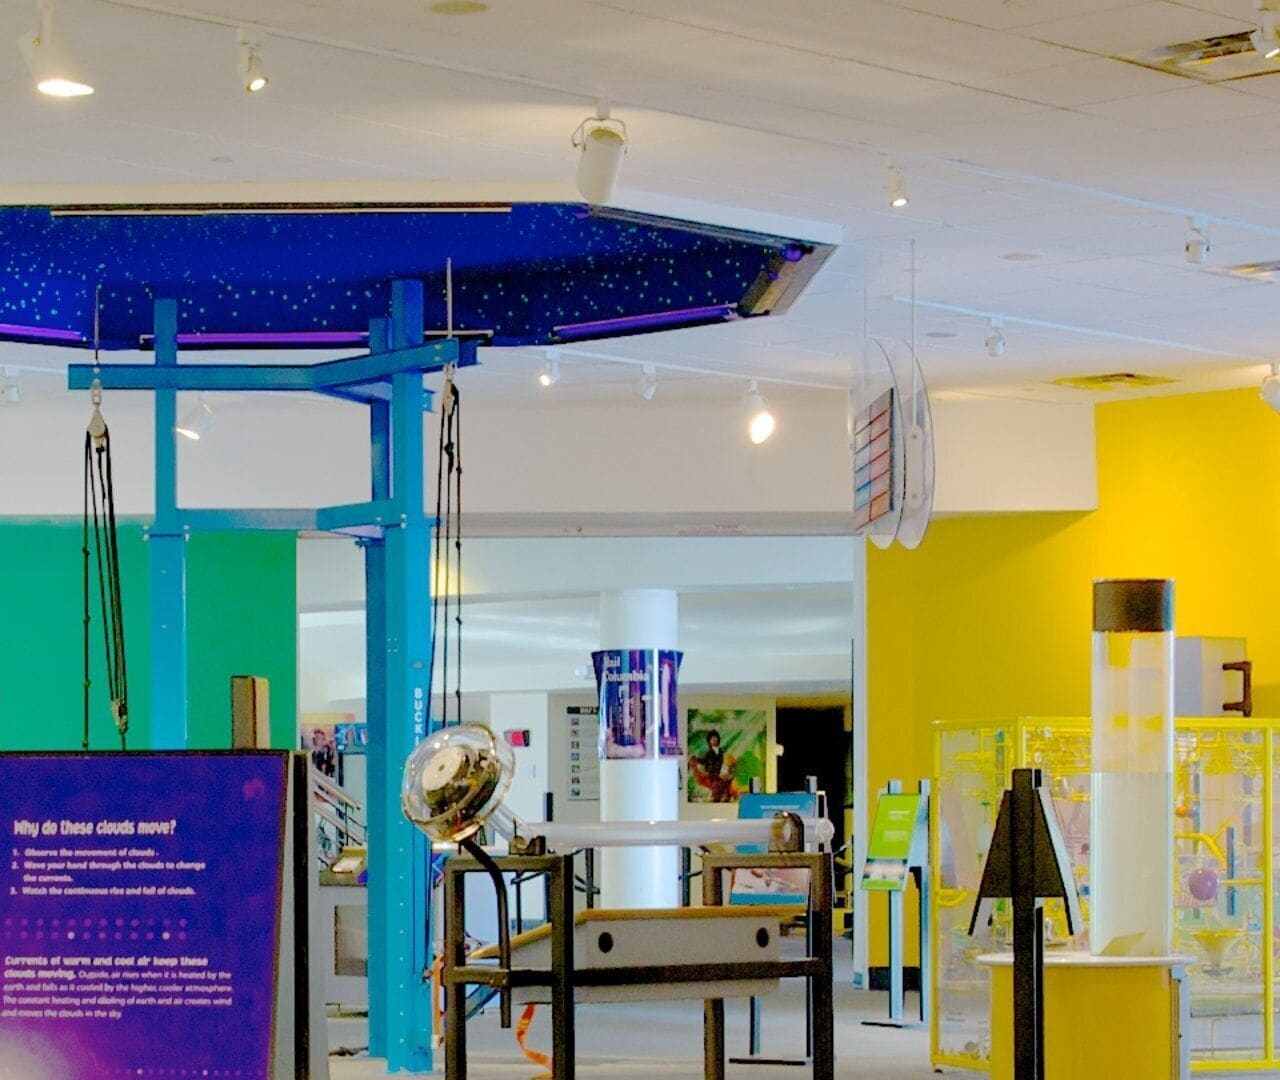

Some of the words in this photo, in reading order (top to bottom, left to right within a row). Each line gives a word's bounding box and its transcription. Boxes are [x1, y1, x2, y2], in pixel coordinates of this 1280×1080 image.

[14, 820, 38, 837] Why
[42, 820, 58, 835] do
[60, 820, 94, 835] these
[96, 820, 134, 835] clouds
[137, 820, 176, 835] move?
[24, 849, 58, 857] Observe
[60, 849, 72, 857] the
[74, 849, 117, 857] movement
[118, 849, 128, 857] of
[47, 862, 66, 870] your
[66, 861, 88, 869] hand
[88, 861, 122, 870] through
[122, 861, 137, 869] the
[138, 861, 164, 869] clouds
[166, 861, 174, 869] to
[176, 861, 206, 870] change
[23, 874, 36, 882] the
[22, 887, 48, 895] Watch
[49, 887, 62, 895] the
[64, 887, 108, 895] continuous
[125, 887, 142, 895] and
[142, 887, 156, 895] fall
[157, 887, 166, 895] of
[5, 956, 48, 966] Currents
[50, 957, 60, 966] of
[62, 957, 91, 966] warm
[92, 957, 112, 966] and
[114, 957, 135, 966] cool
[136, 956, 152, 966] air
[152, 957, 178, 966] keep
[180, 957, 208, 966] these
[4, 970, 36, 978] clouds
[140, 971, 162, 979] when
[178, 971, 206, 979] heated
[206, 971, 217, 981] by
[218, 971, 232, 979] the
[104, 983, 114, 992] by
[1, 1009, 17, 1017] and
[43, 1009, 58, 1017] the
[58, 1009, 84, 1017] clouds
[94, 1009, 108, 1017] the
